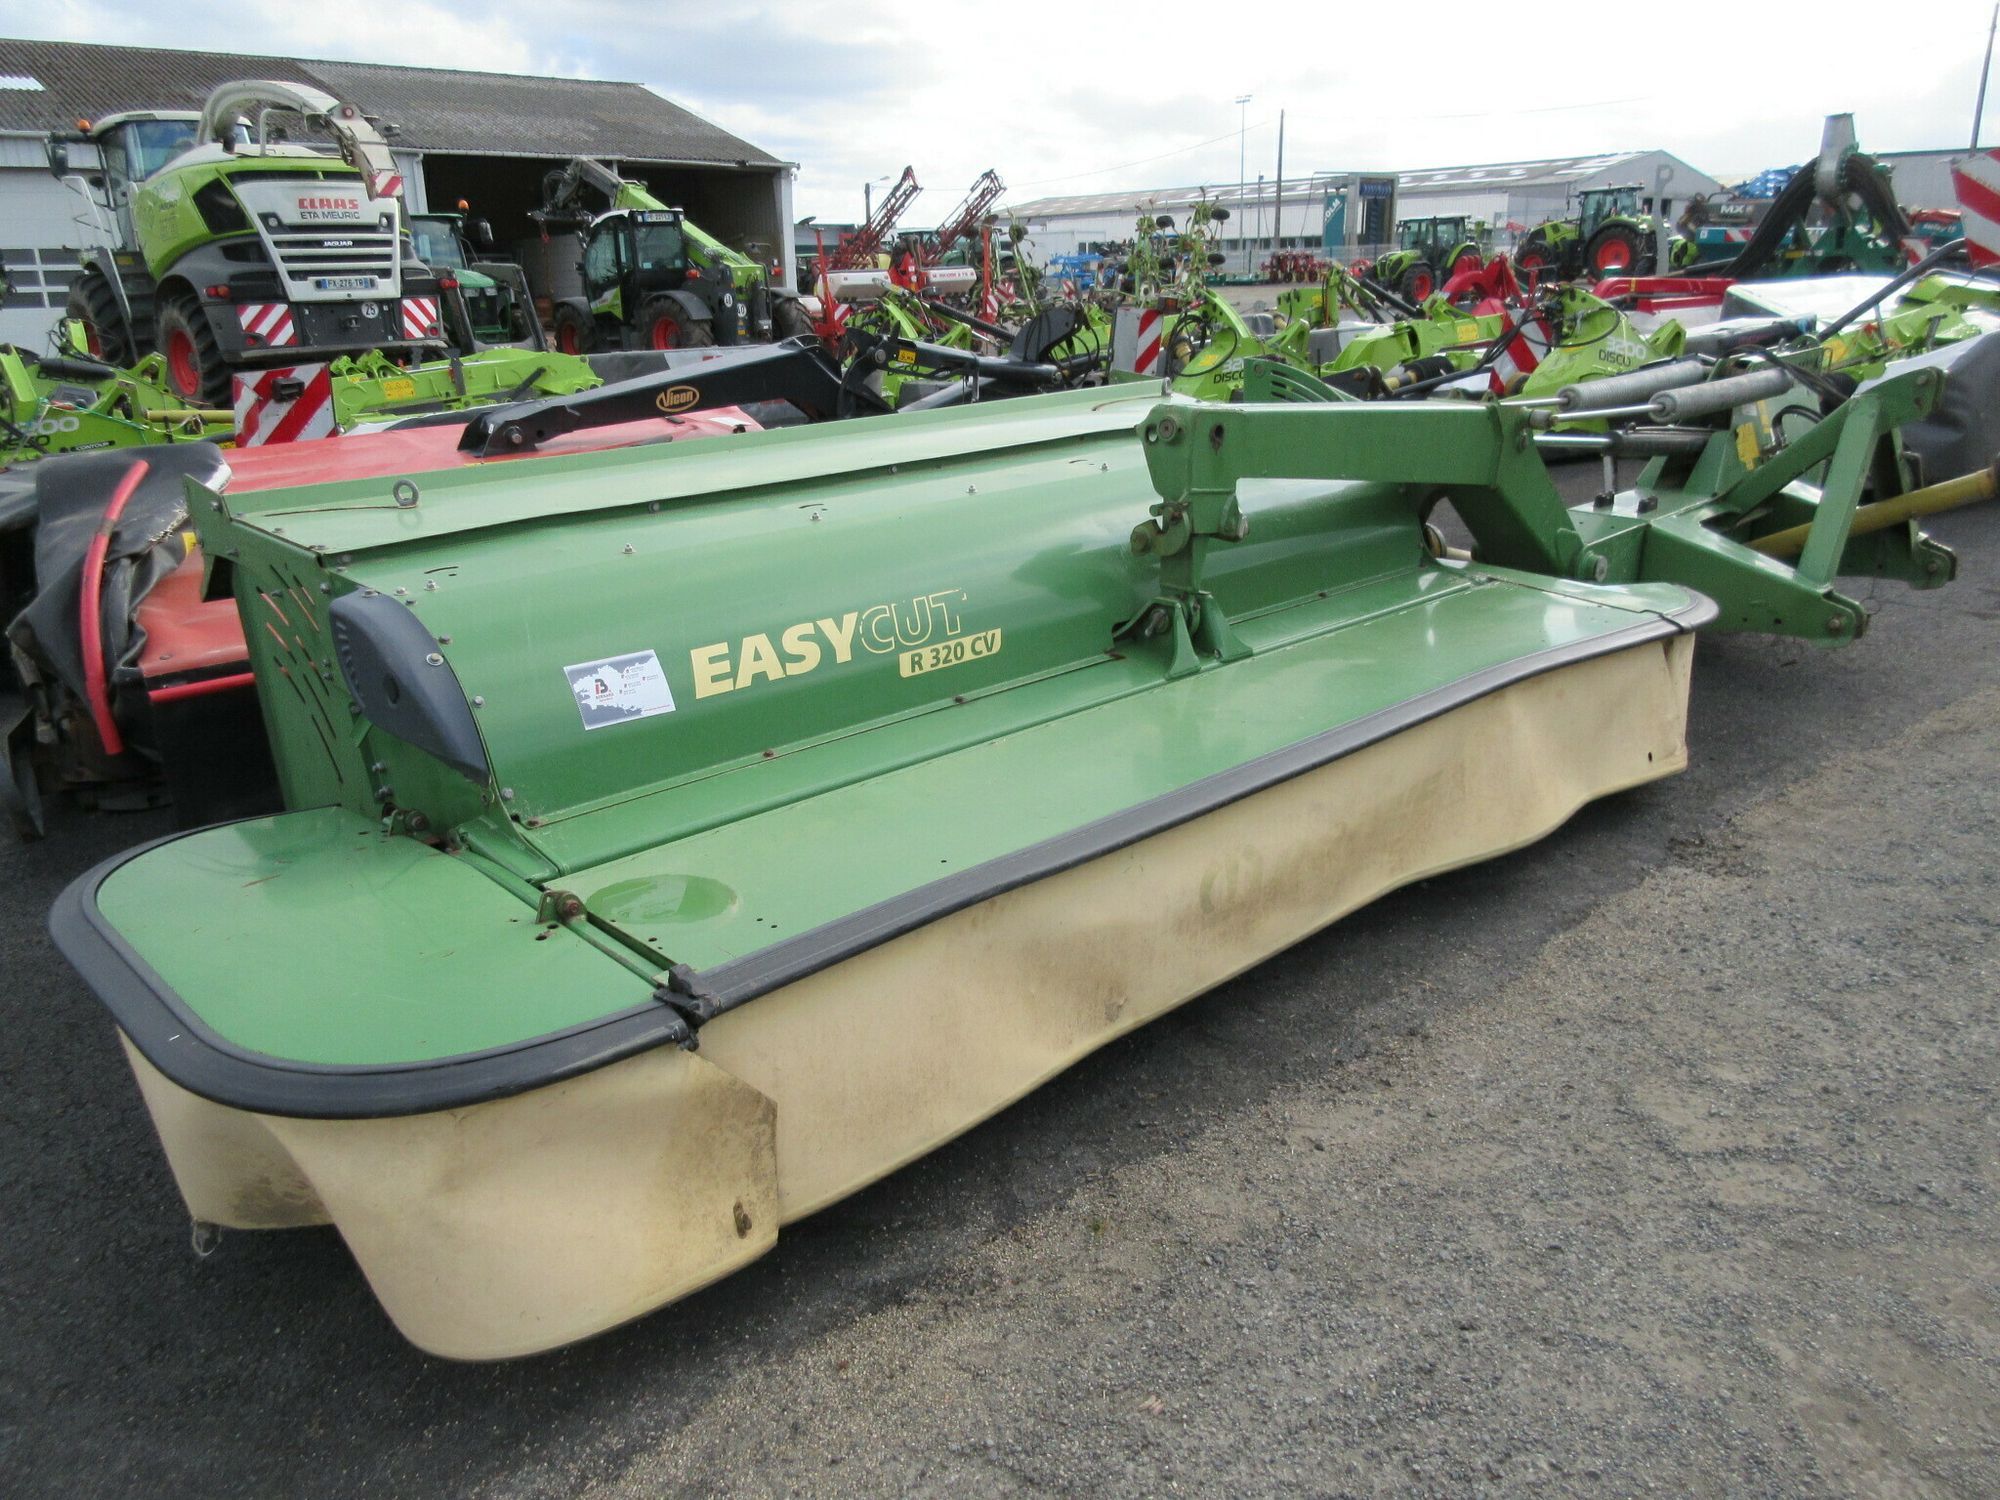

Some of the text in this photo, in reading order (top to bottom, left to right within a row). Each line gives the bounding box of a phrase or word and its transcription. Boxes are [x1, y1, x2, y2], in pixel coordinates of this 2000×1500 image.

[298, 198, 359, 209] CLAAS
[300, 211, 360, 220] ETA MEURIC
[365, 303, 376, 316] 25
[1598, 348, 1632, 368] DISCO
[662, 389, 694, 407] Vicon
[909, 632, 996, 674] R 320 CV
